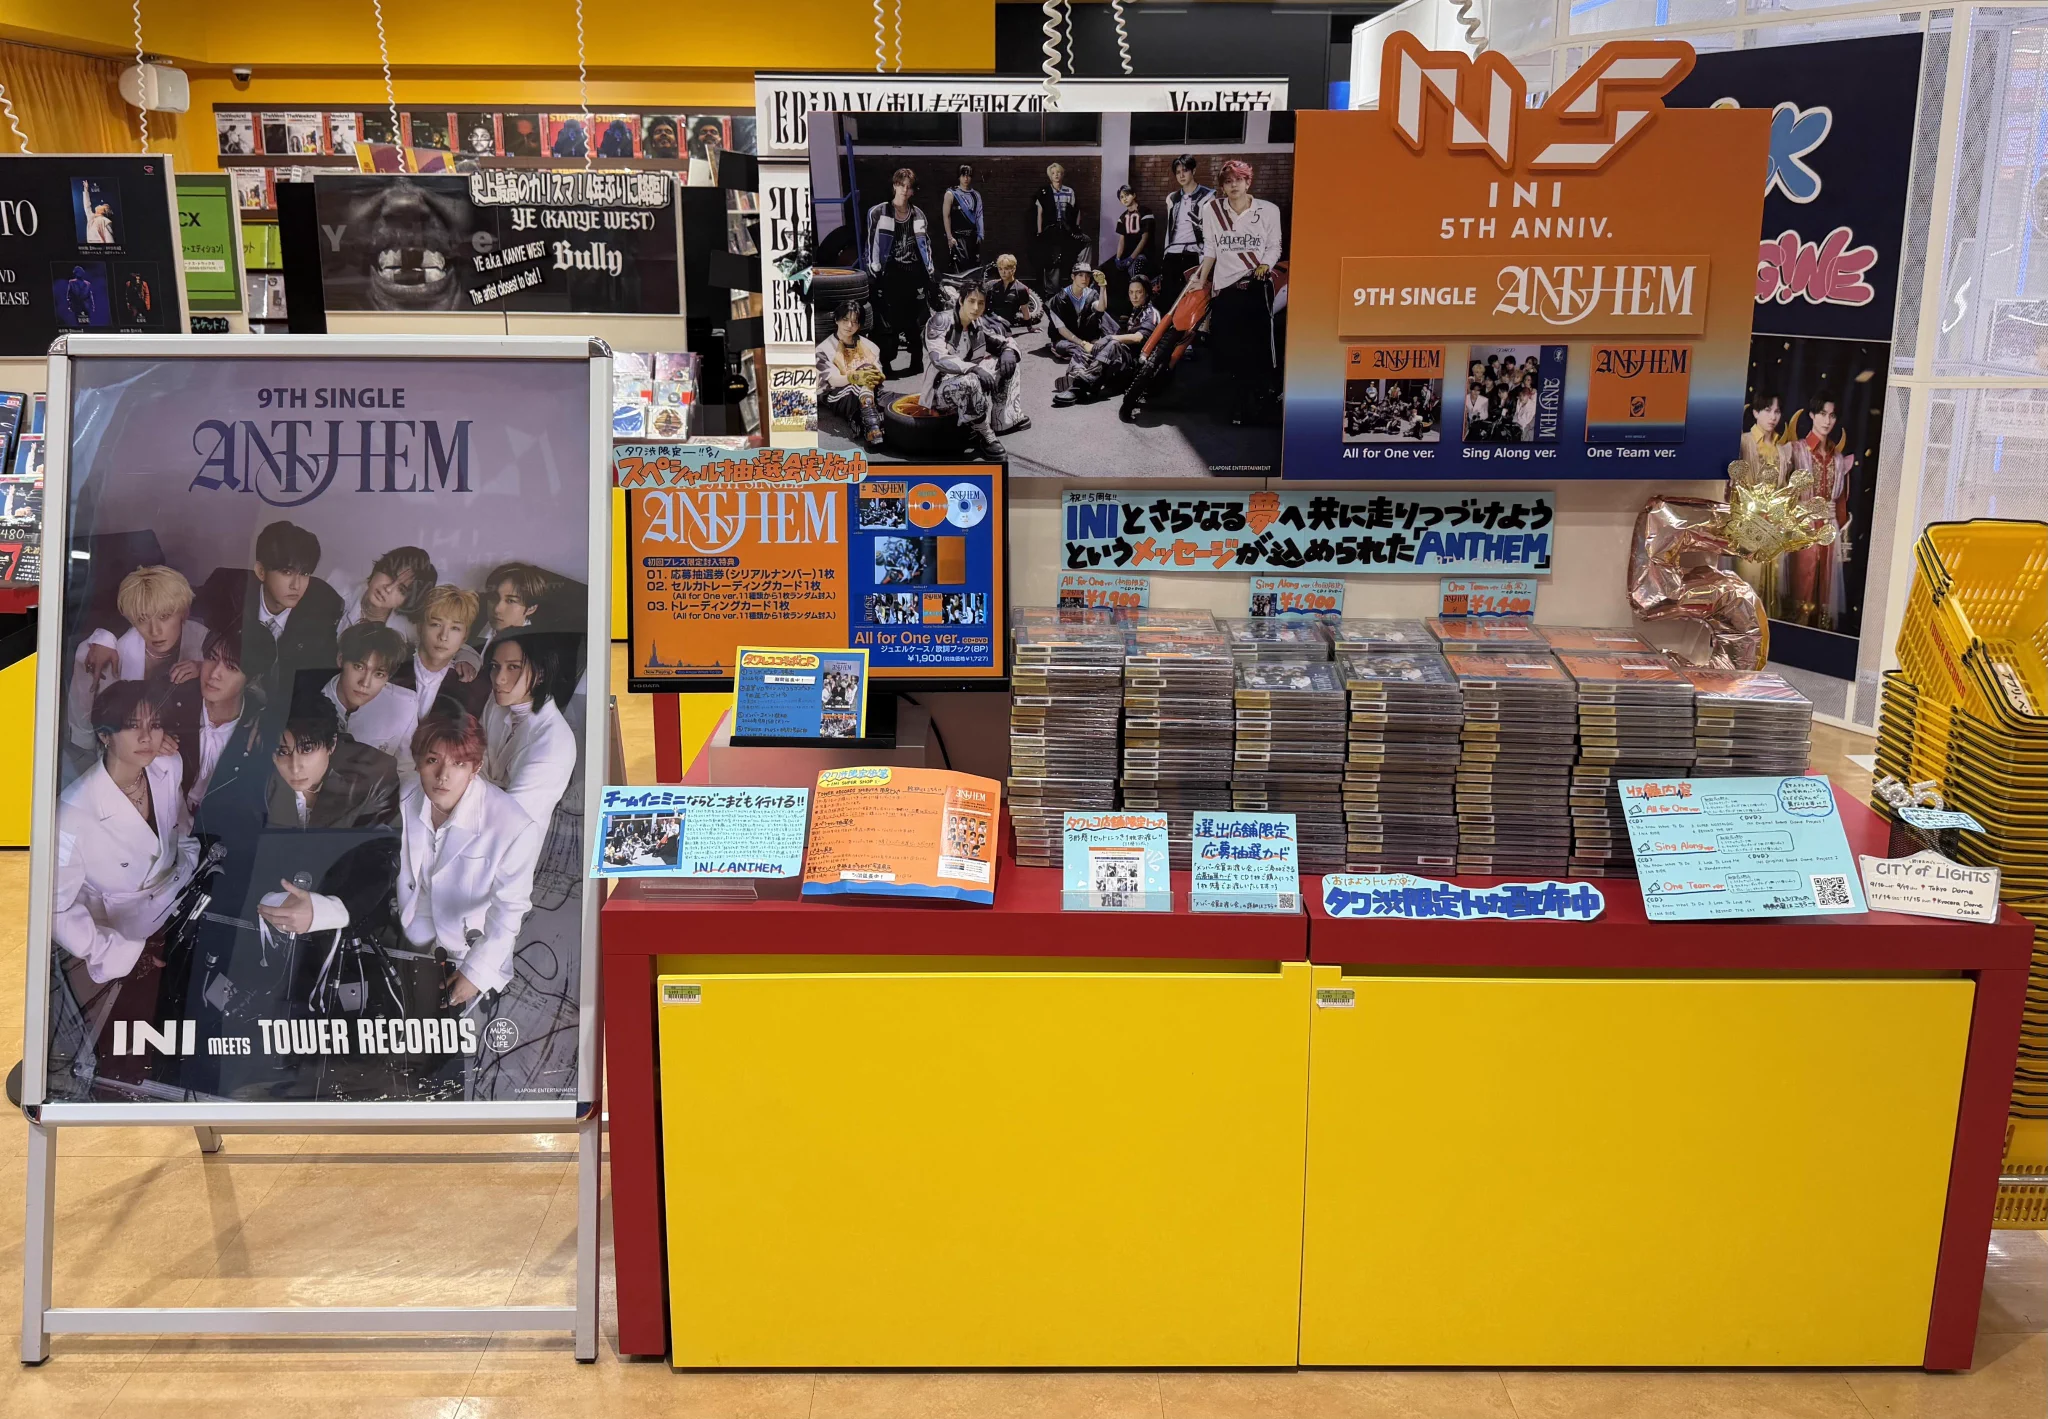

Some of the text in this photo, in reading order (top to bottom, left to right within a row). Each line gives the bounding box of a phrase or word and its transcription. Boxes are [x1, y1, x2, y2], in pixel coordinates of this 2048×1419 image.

[1489, 182, 1562, 208] INI
[511, 208, 538, 231] YE
[602, 211, 655, 230] WEST)
[1125, 214, 1140, 233] 10
[1251, 208, 1262, 223] 5
[1439, 217, 1613, 239] 5TH ANNIV.
[322, 225, 493, 253] Y e
[473, 256, 484, 272] YE
[502, 245, 527, 265] KANYE
[527, 240, 546, 259] WEST
[553, 240, 622, 276] Bully
[469, 289, 483, 305] The
[483, 284, 498, 302] artist
[498, 276, 519, 298] closest
[519, 277, 526, 289] to
[525, 271, 537, 287] God
[1353, 265, 1696, 325] 9TH SINGLE ANTHEM
[1372, 350, 1440, 371] ANTHEM
[1595, 349, 1687, 378] ANTHEM
[774, 369, 816, 387] EBiDA
[257, 388, 405, 408] 9TH SINGLE
[1538, 378, 1561, 438] ANTHEM
[1343, 447, 1435, 458] All for One ver.
[1462, 447, 1556, 460] Sing Along ver.
[1587, 447, 1676, 458] One Team ver.
[189, 419, 473, 507] ANTHEM
[618, 450, 866, 487] スペシャル抽選会実施中
[642, 491, 839, 554] ANTHEM
[648, 558, 735, 567] 初回プレス限定封入特典
[1256, 579, 1275, 589] Sing
[854, 631, 873, 644] All
[877, 631, 897, 644] for
[901, 631, 932, 644] One
[935, 633, 960, 644] ver.
[907, 654, 942, 663] ¥1,900
[1646, 805, 1658, 813] All
[1659, 804, 1670, 812] for
[1672, 804, 1688, 812] One
[1195, 818, 1289, 839] 選出店舗限定
[1201, 841, 1290, 860] 応募抽選カード
[1654, 842, 1704, 851] Sing Along
[1876, 863, 1912, 875] CITY
[1915, 865, 1931, 877] of
[1663, 882, 1683, 891] One
[1687, 881, 1711, 890] Team
[1952, 887, 1974, 895] Dome
[1964, 900, 1984, 908] Dome
[113, 1018, 477, 1056] INI MEETS TOWER RECORDS
